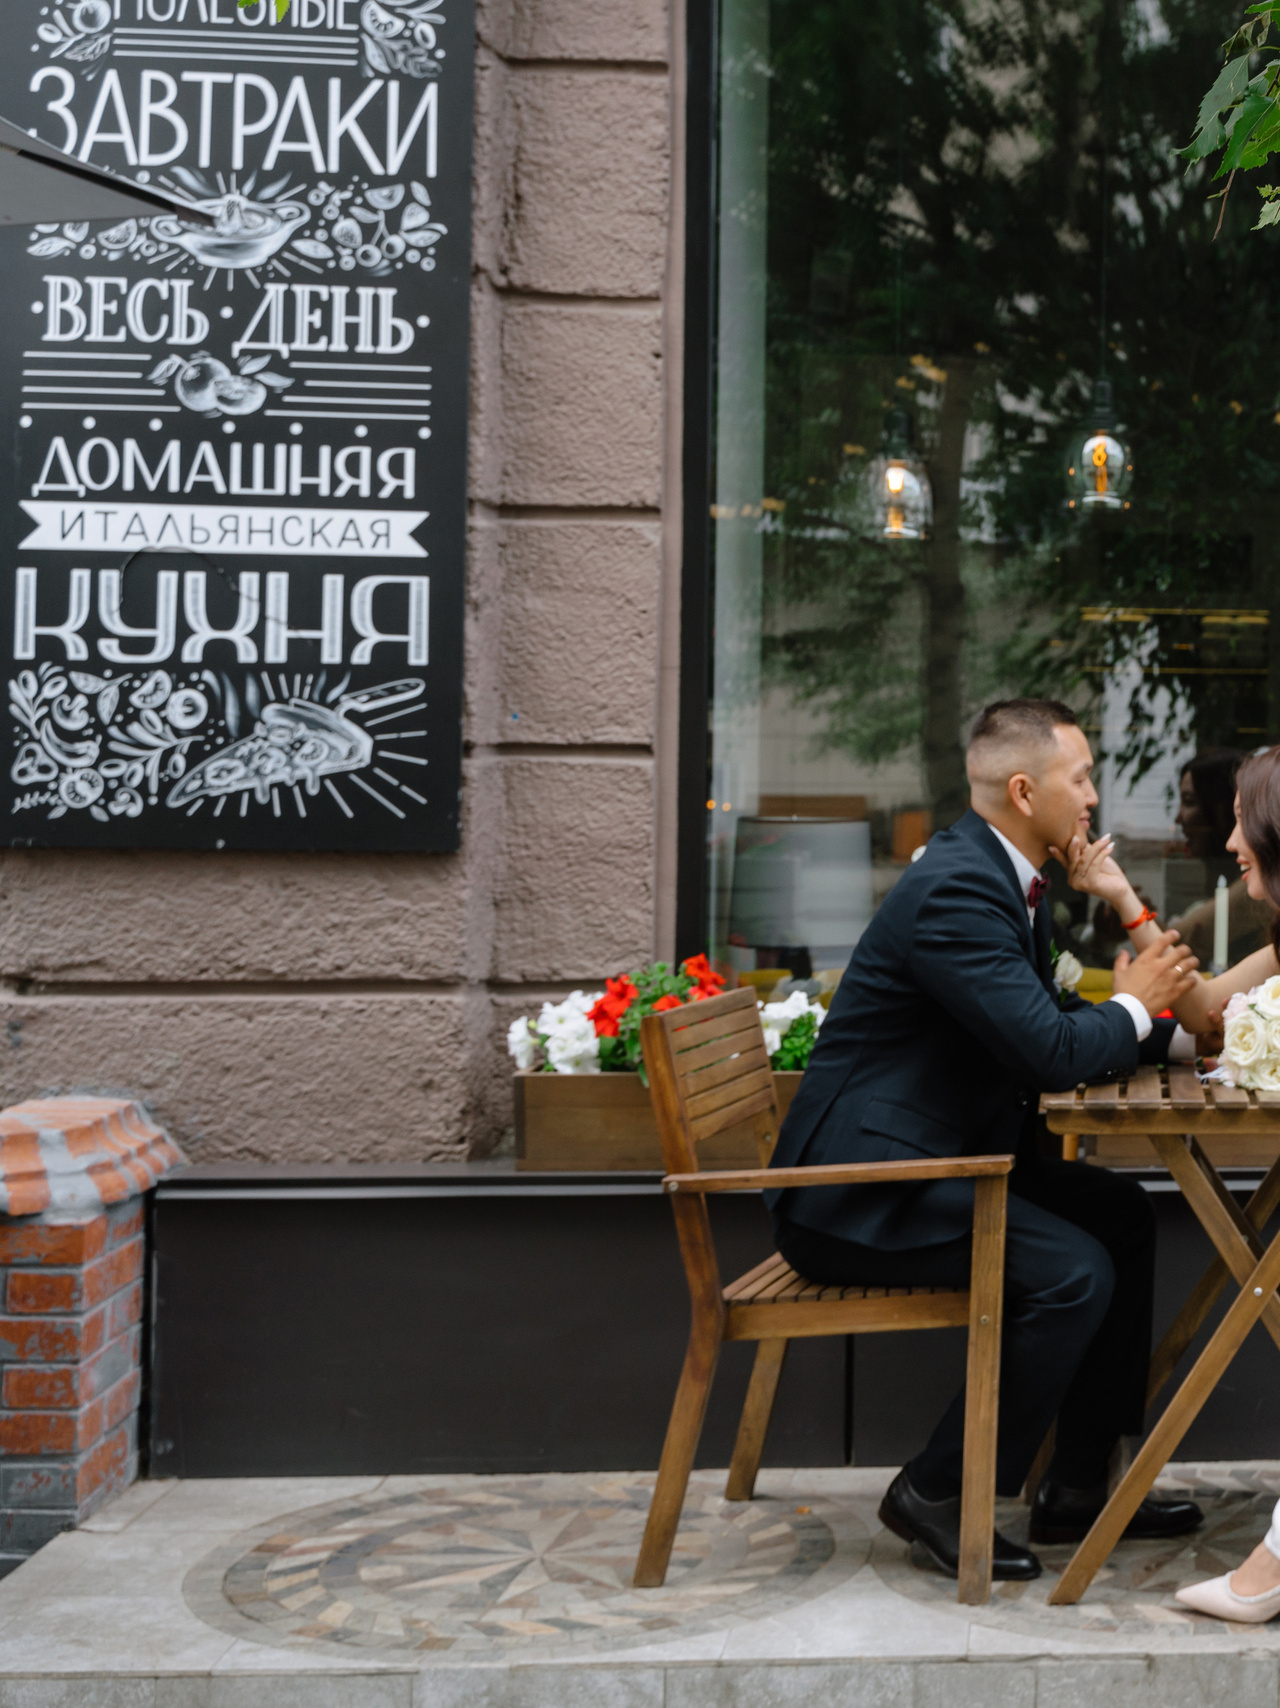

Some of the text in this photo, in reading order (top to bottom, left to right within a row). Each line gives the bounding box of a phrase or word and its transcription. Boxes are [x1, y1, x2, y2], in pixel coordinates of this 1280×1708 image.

[29, 65, 438, 178] ЗАВТРАКИ
[41, 274, 415, 359] ВЕСЬ ДЕНЬ
[31, 435, 416, 500] ДОМАШНЯЯ
[60, 509, 392, 549] ИТАЛЬЯНСКАЯ
[13, 566, 430, 667] КУХНЯ
